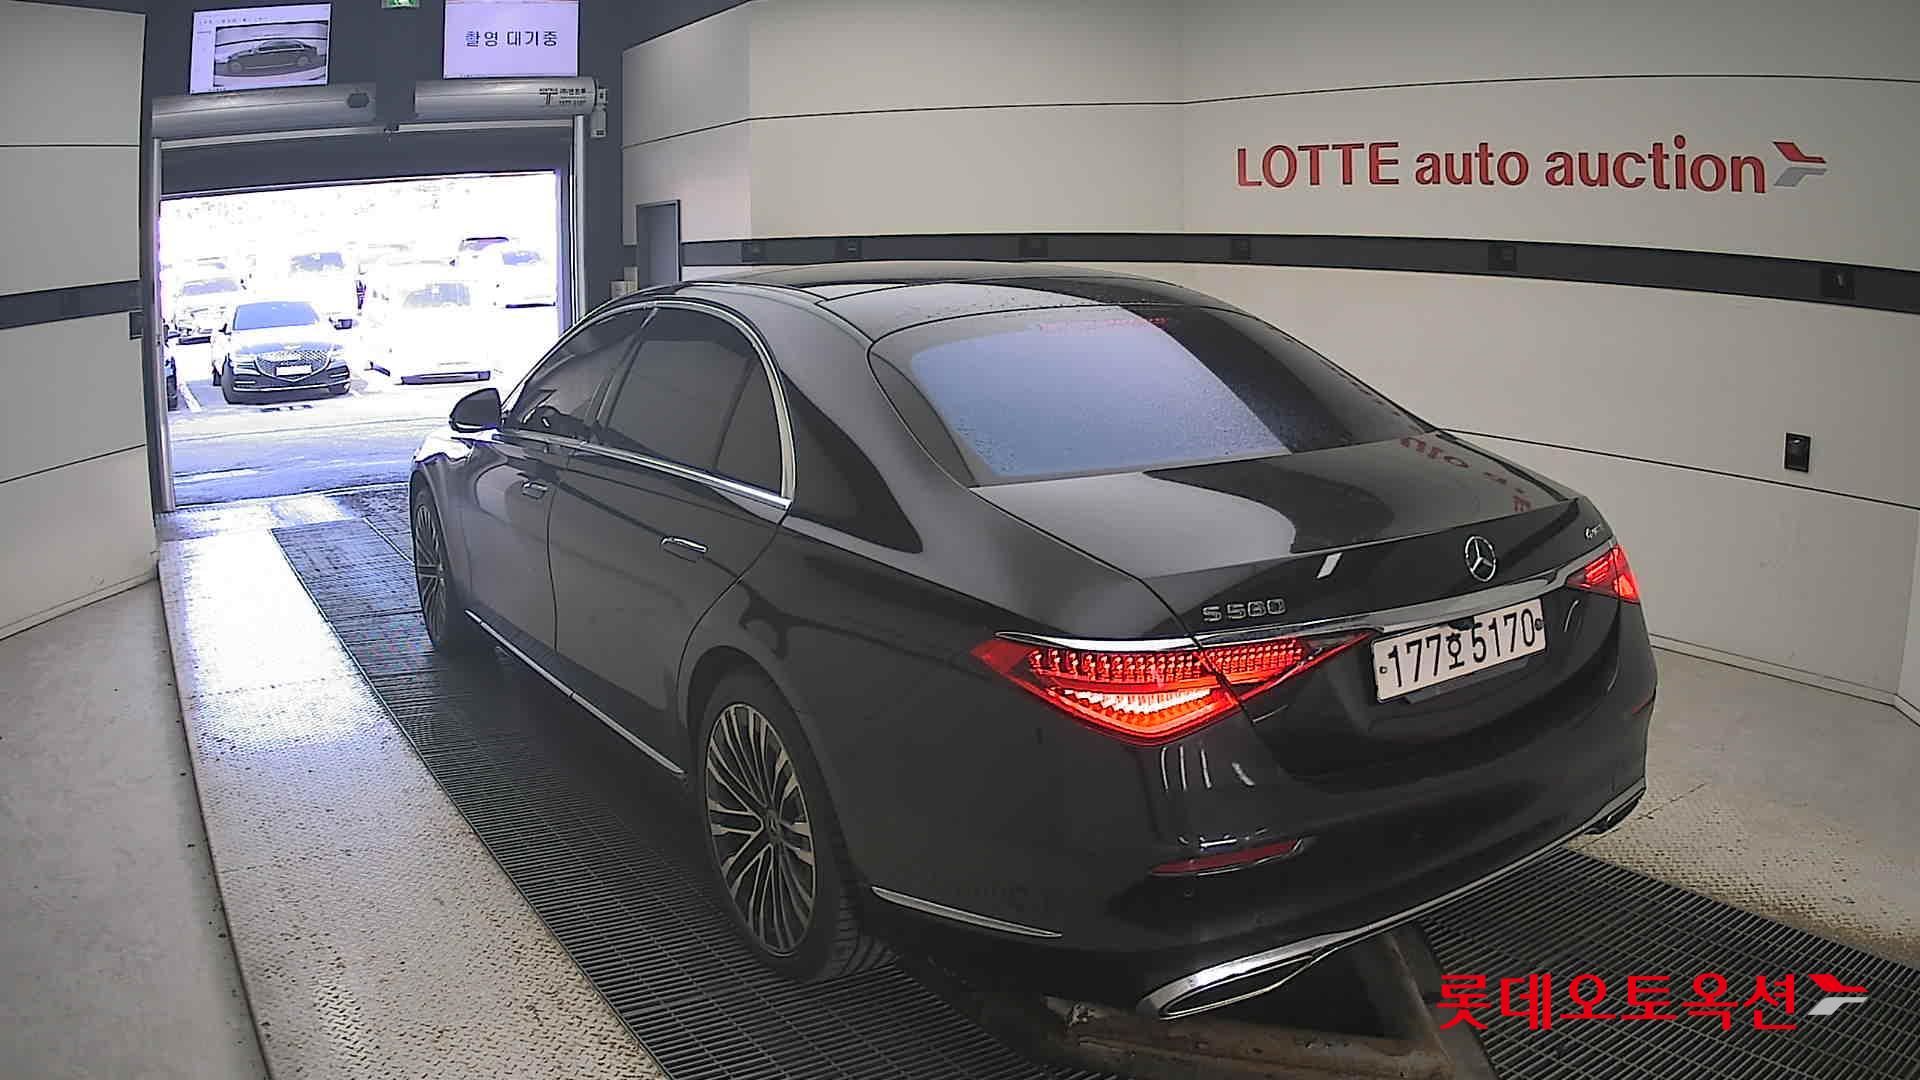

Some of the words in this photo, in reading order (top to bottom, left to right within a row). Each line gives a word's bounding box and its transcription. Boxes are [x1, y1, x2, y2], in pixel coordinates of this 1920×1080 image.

[1236, 142, 1399, 188] LOTTE
[1415, 142, 1529, 185] auto
[1545, 134, 1767, 193] auction
[1202, 605, 1222, 622] S
